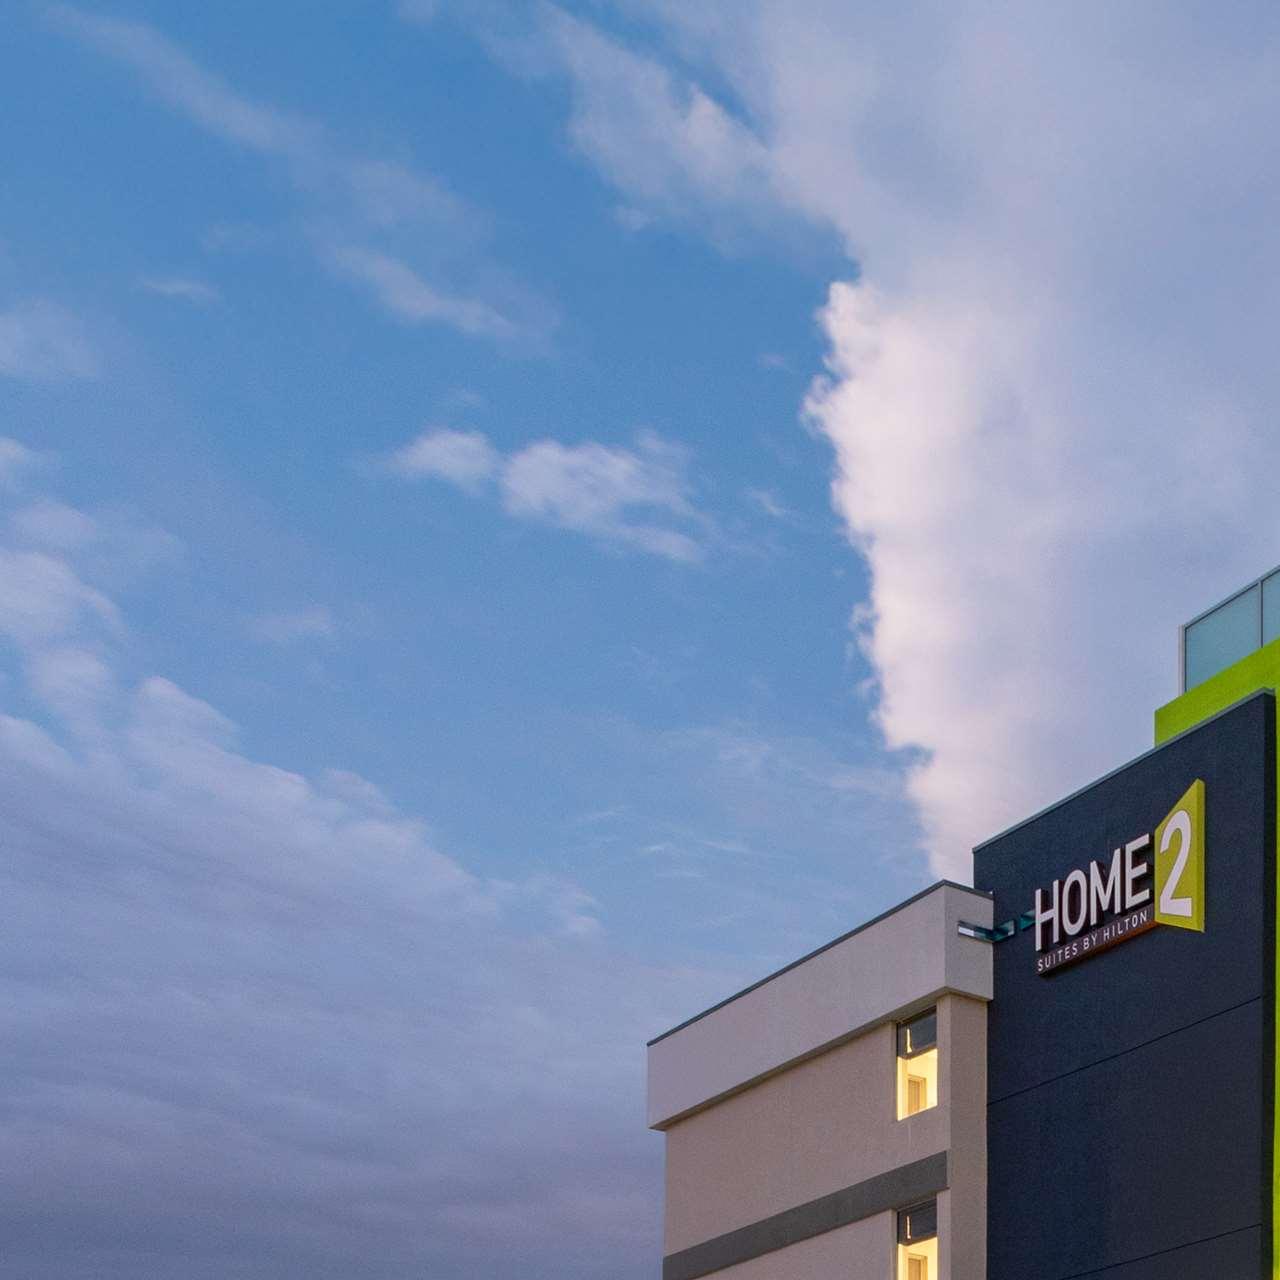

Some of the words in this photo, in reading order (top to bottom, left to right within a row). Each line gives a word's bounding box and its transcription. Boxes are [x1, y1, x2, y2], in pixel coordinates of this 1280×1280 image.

[1037, 943, 1079, 972] SUITES
[1082, 932, 1098, 950] BY
[1102, 910, 1149, 942] HILTON
